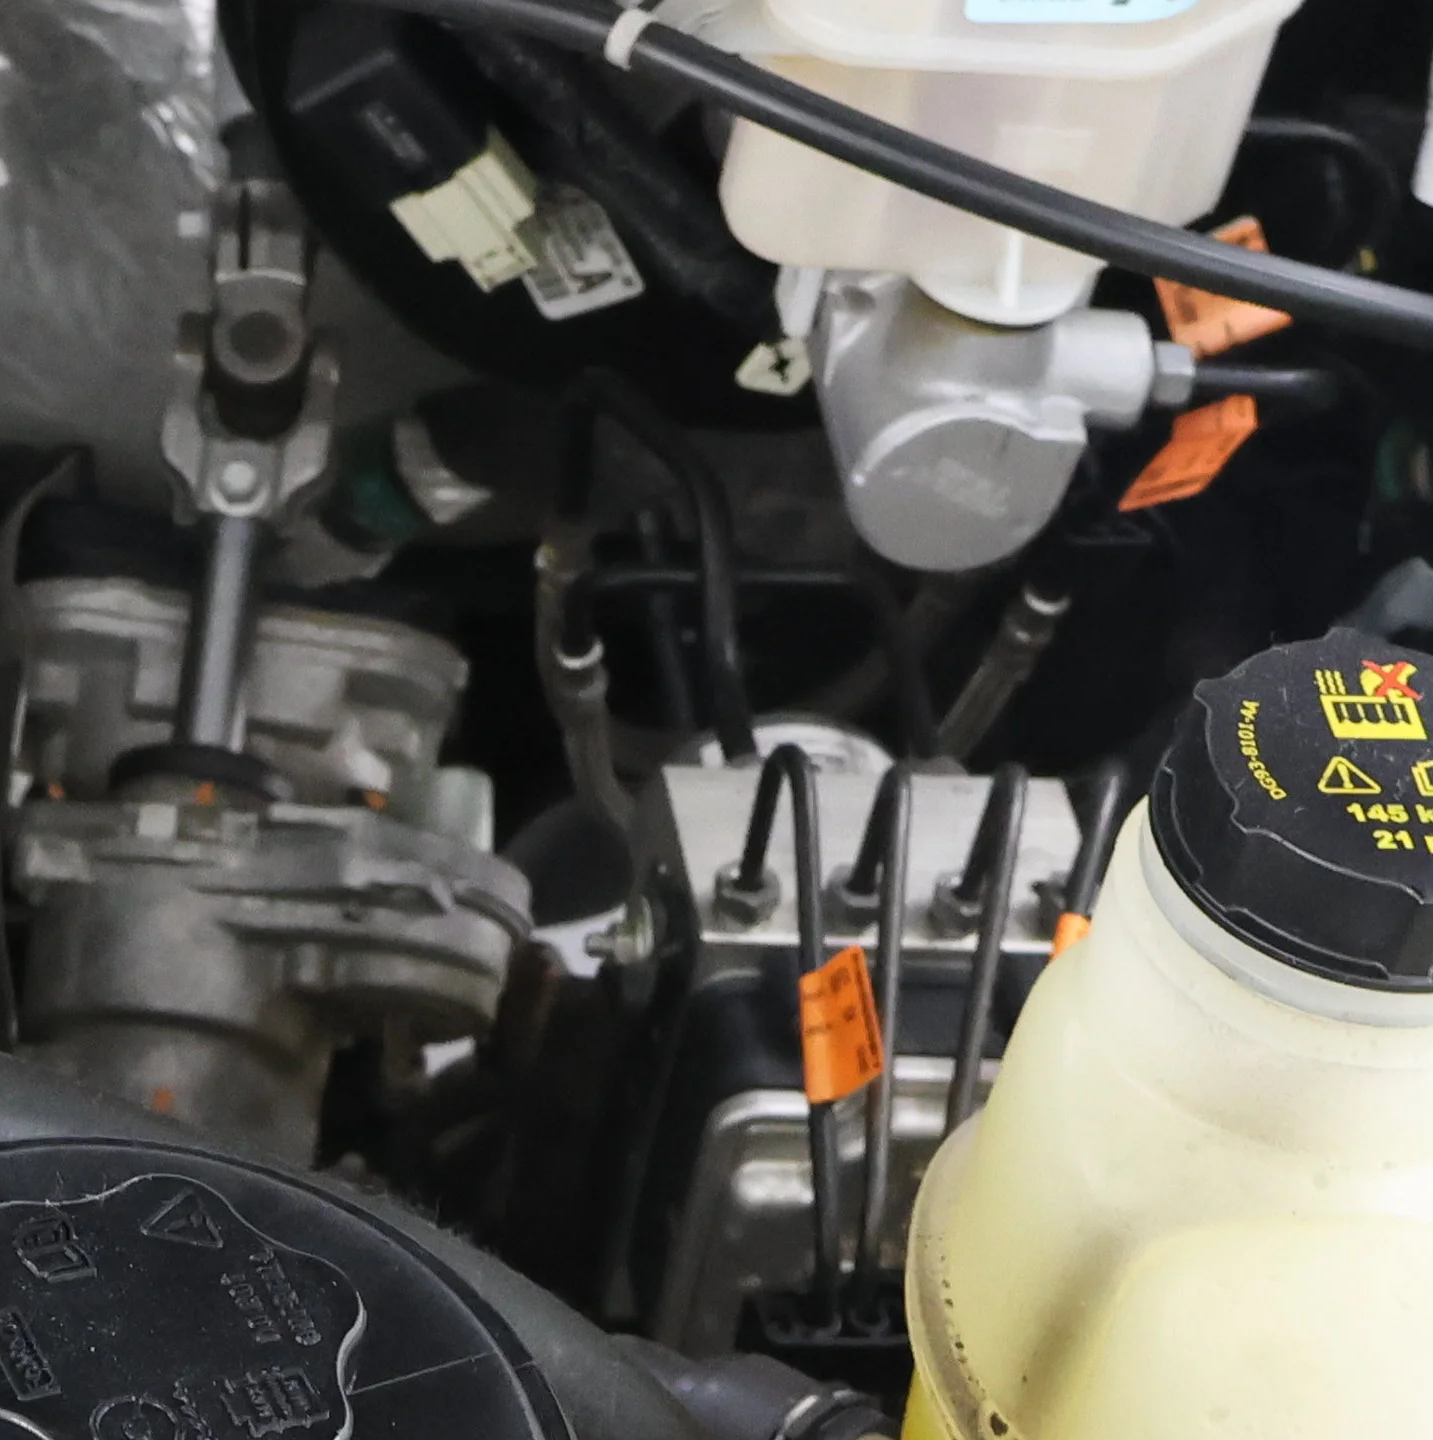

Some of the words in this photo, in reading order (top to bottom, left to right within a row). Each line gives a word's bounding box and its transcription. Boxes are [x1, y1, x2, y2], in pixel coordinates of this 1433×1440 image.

[1238, 700, 1288, 801] DG93-8101-AA
[1346, 802, 1410, 825] 145
[1372, 830, 1415, 850] 21
